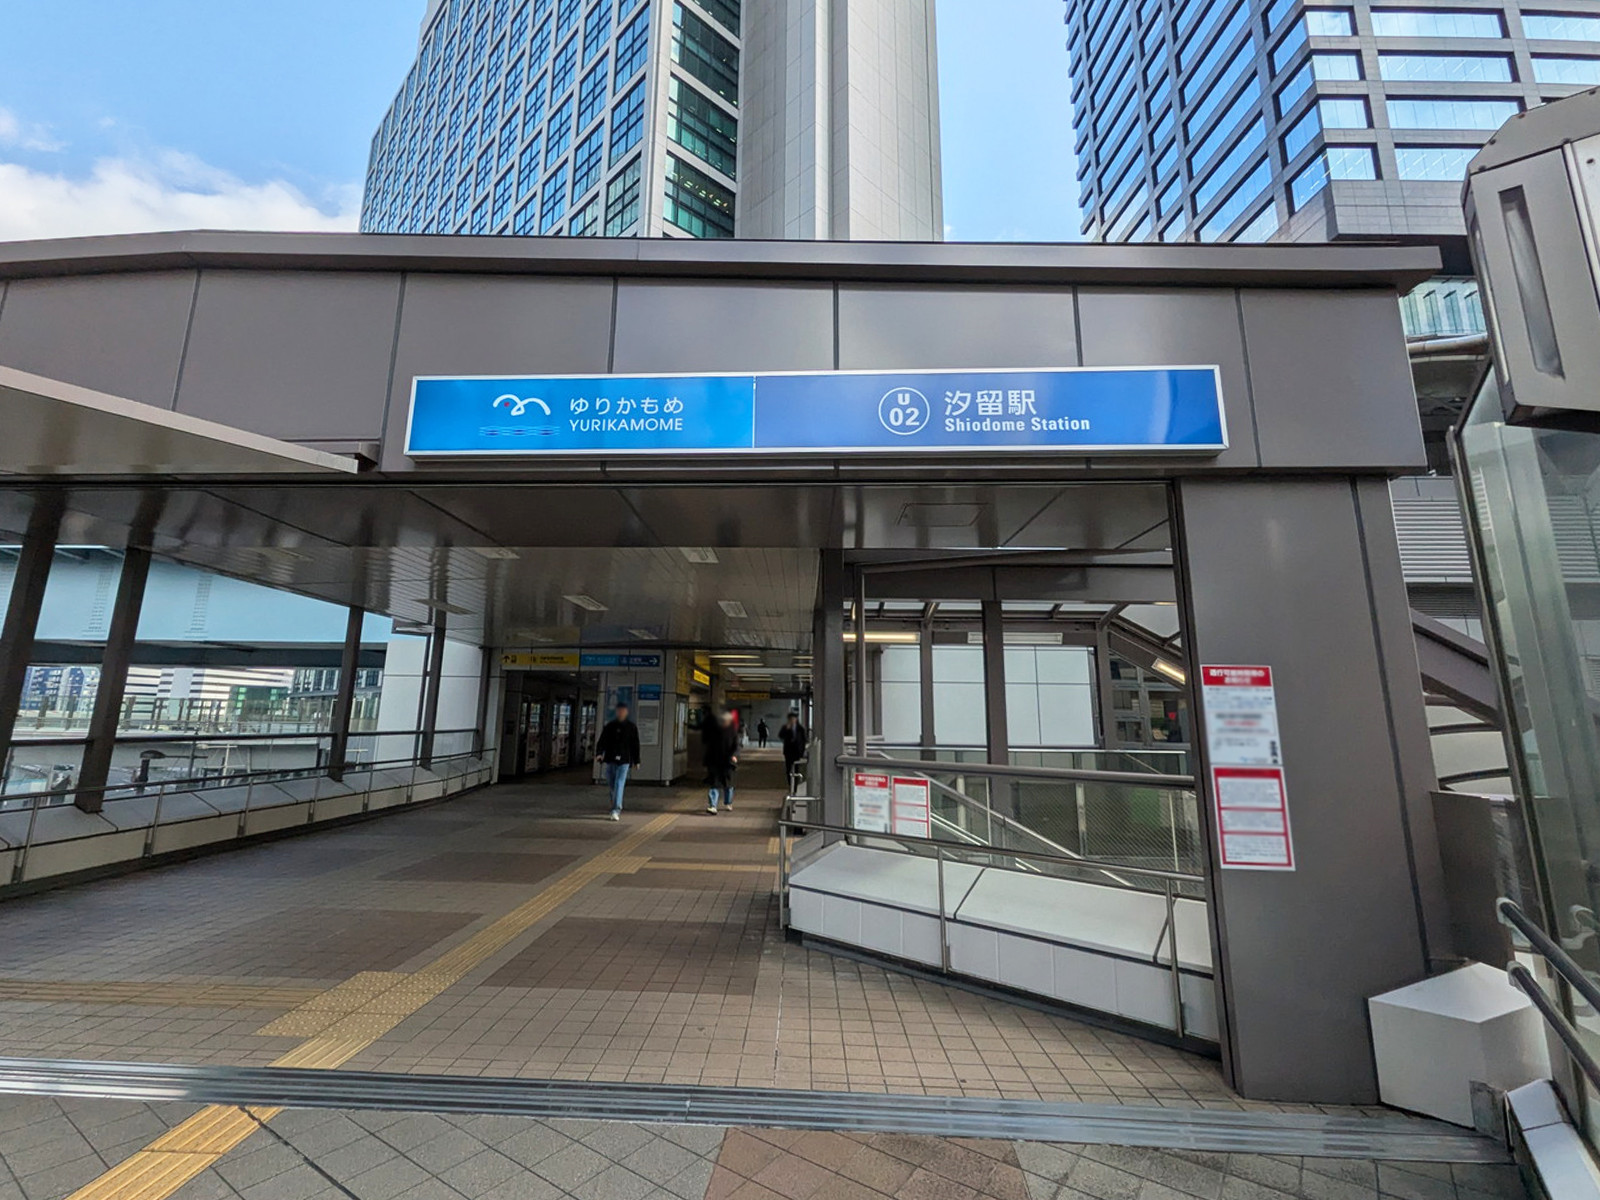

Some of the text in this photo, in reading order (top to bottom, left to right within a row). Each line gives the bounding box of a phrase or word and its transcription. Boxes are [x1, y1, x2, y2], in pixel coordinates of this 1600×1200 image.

[569, 397, 684, 415] ゆりかもめ
[897, 393, 910, 406] U
[944, 389, 1037, 415] 汐留駅
[569, 417, 683, 432] YURIKAMOME
[889, 407, 920, 427] 02
[944, 416, 1091, 432] Shiodome Station
